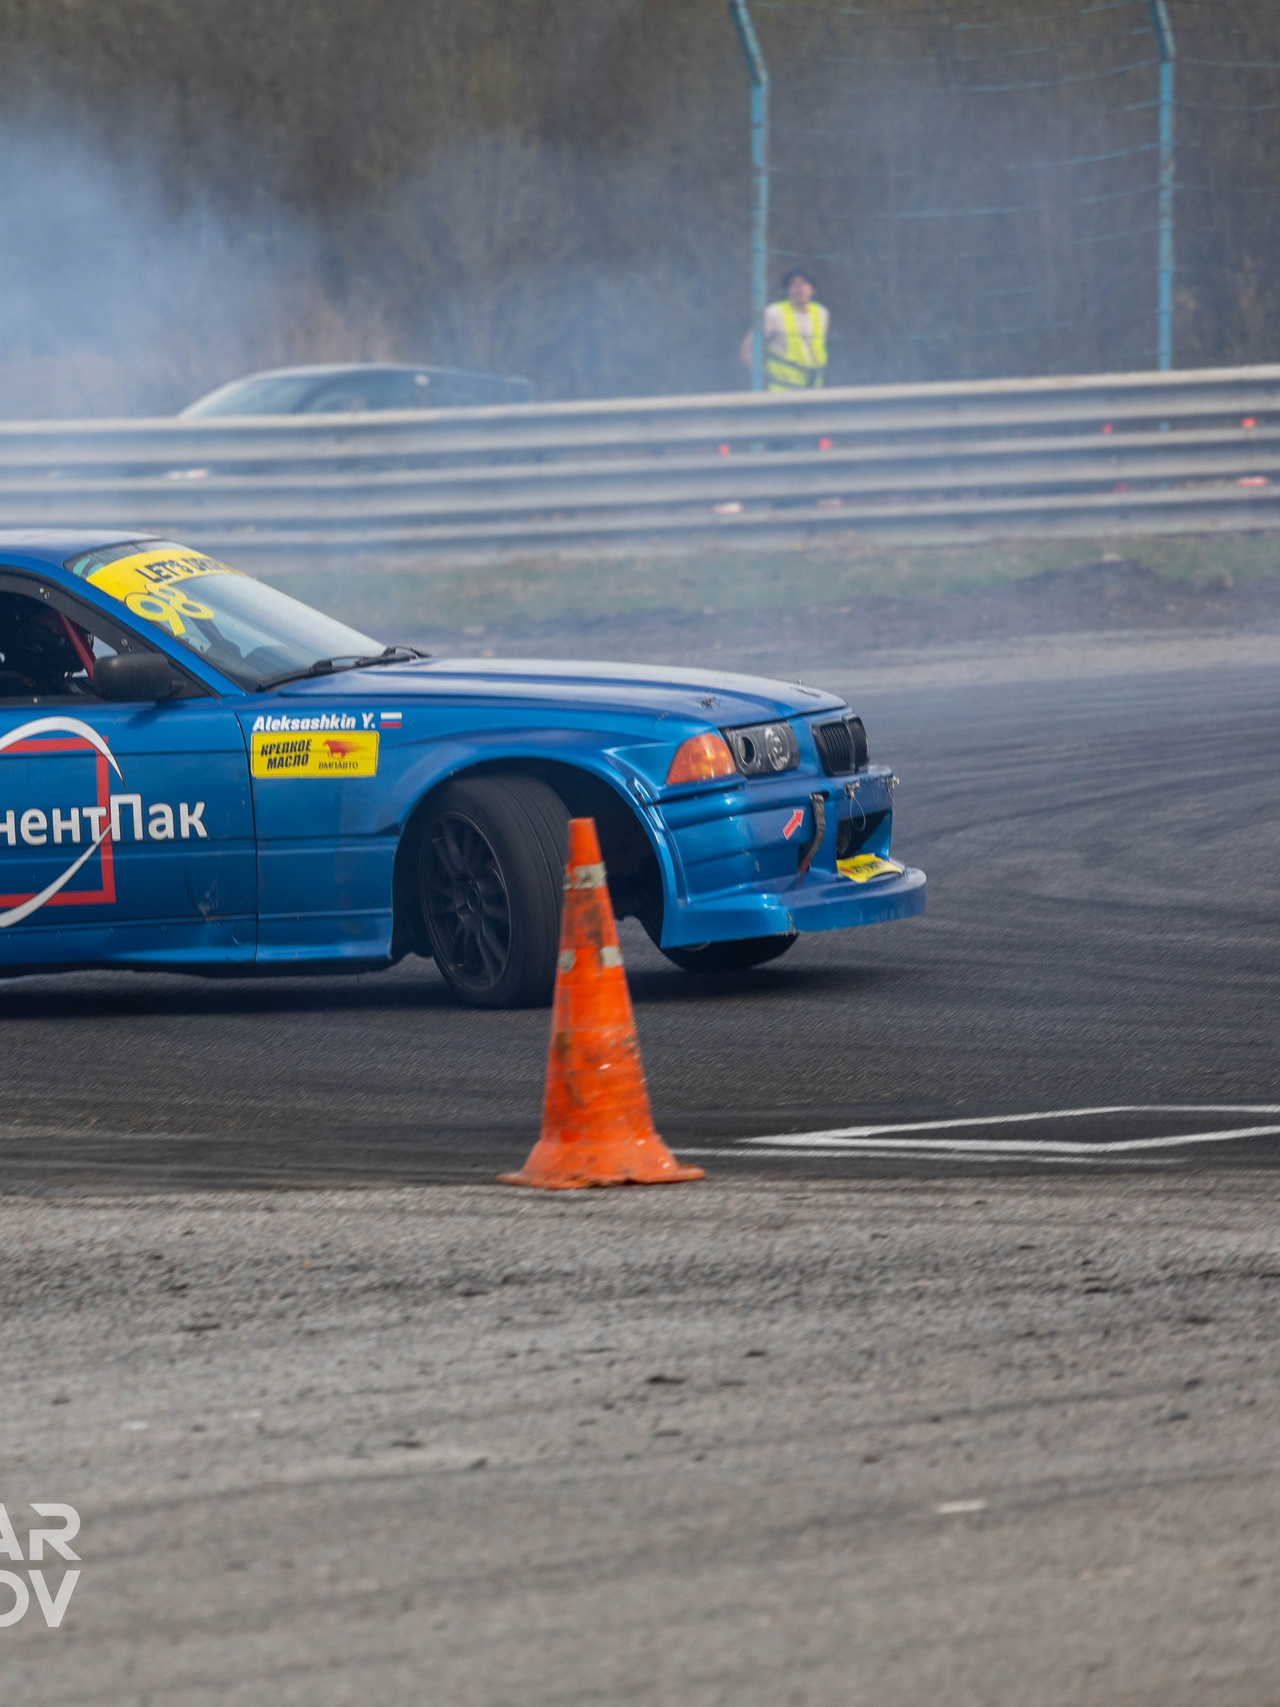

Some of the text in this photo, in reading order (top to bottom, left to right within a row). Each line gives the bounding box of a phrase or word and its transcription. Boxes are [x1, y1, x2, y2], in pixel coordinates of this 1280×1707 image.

[124, 582, 215, 636] 98
[252, 712, 376, 731] Aleksashkin Y.
[261, 739, 313, 757] КРЕПКОЕ
[267, 753, 309, 770] МАСЛО
[318, 761, 359, 770] ВМПАВТО
